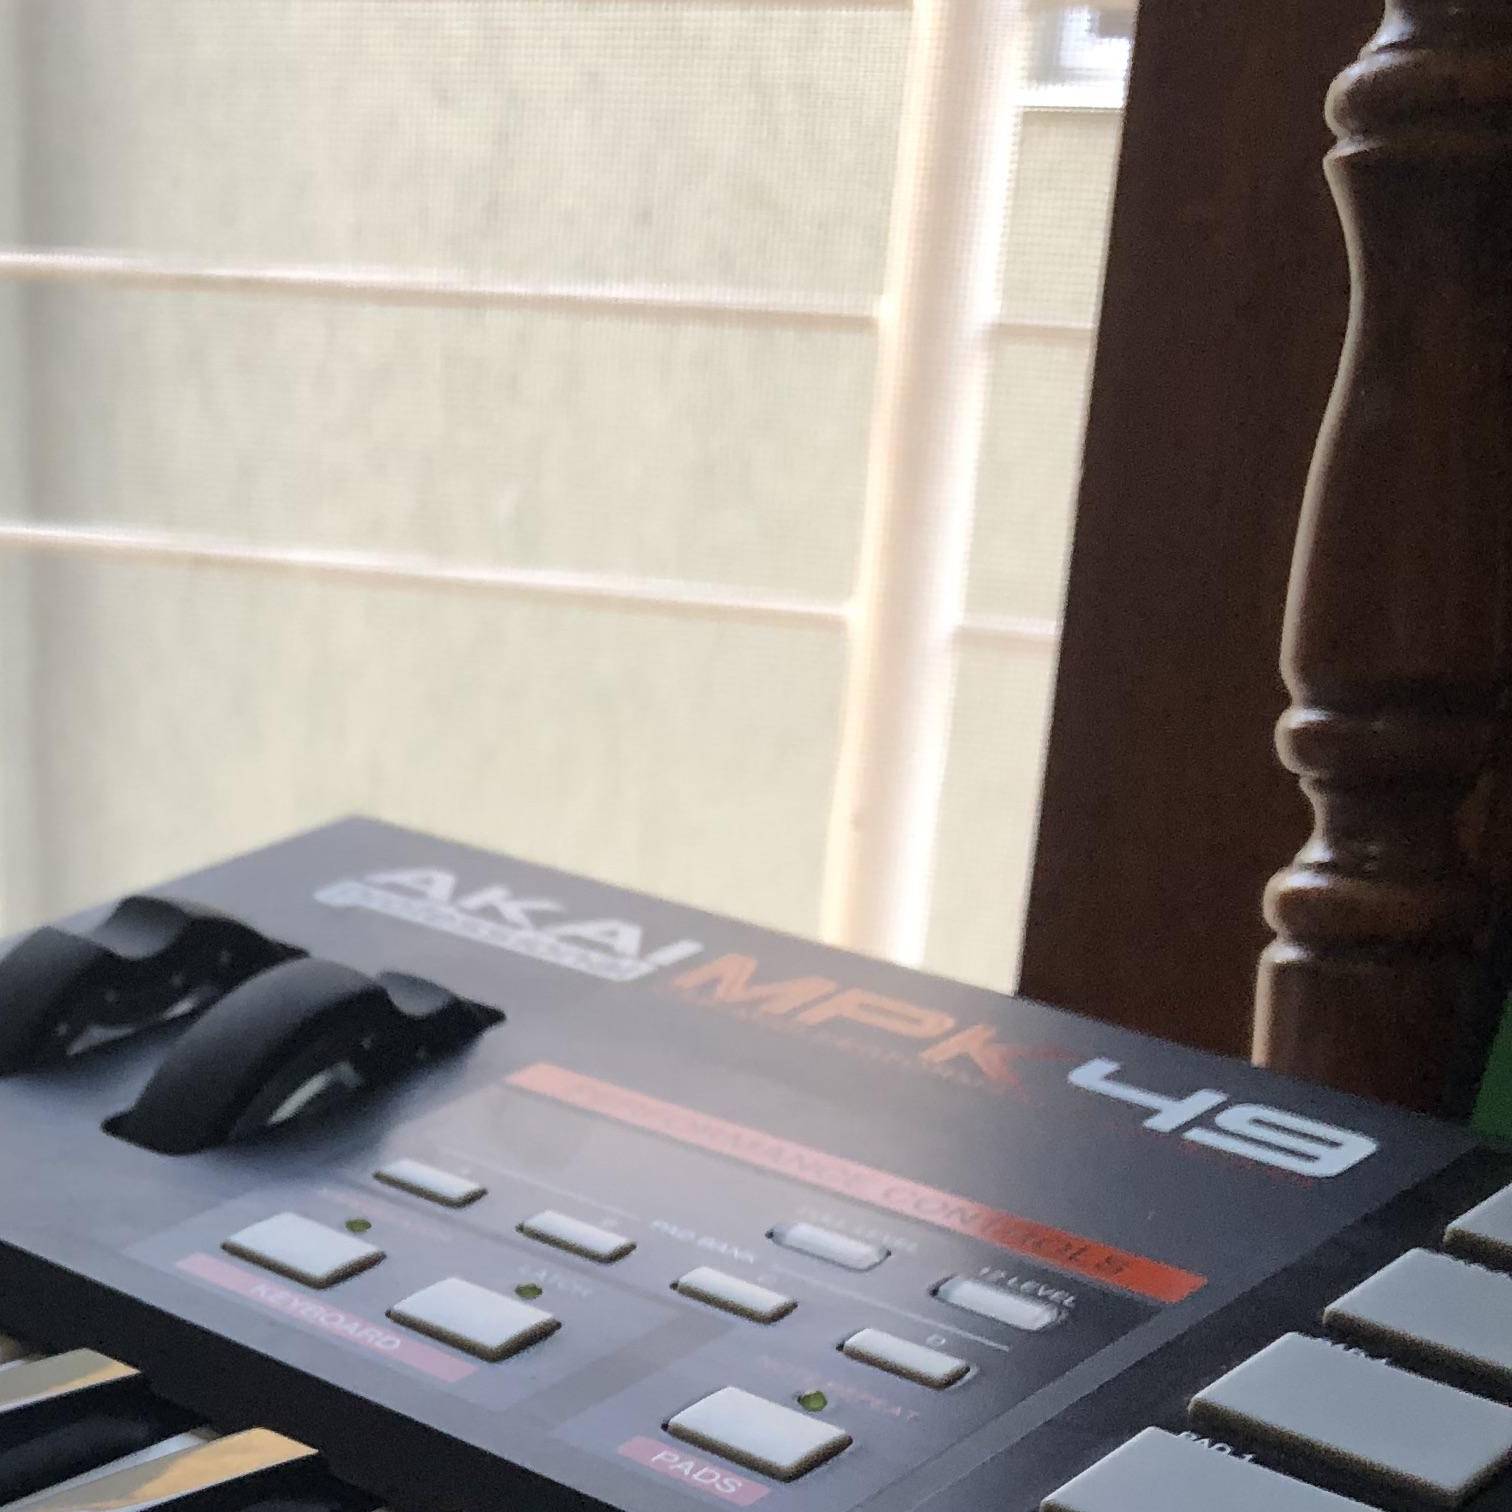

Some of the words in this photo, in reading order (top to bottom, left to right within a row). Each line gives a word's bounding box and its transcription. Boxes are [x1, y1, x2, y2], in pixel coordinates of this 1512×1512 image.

[316, 867, 704, 980] AKAI
[670, 952, 1023, 1092] MPK
[1067, 1056, 1381, 1180] 49
[249, 1283, 402, 1350] KEYBOARD
[650, 1448, 744, 1496] PADS
